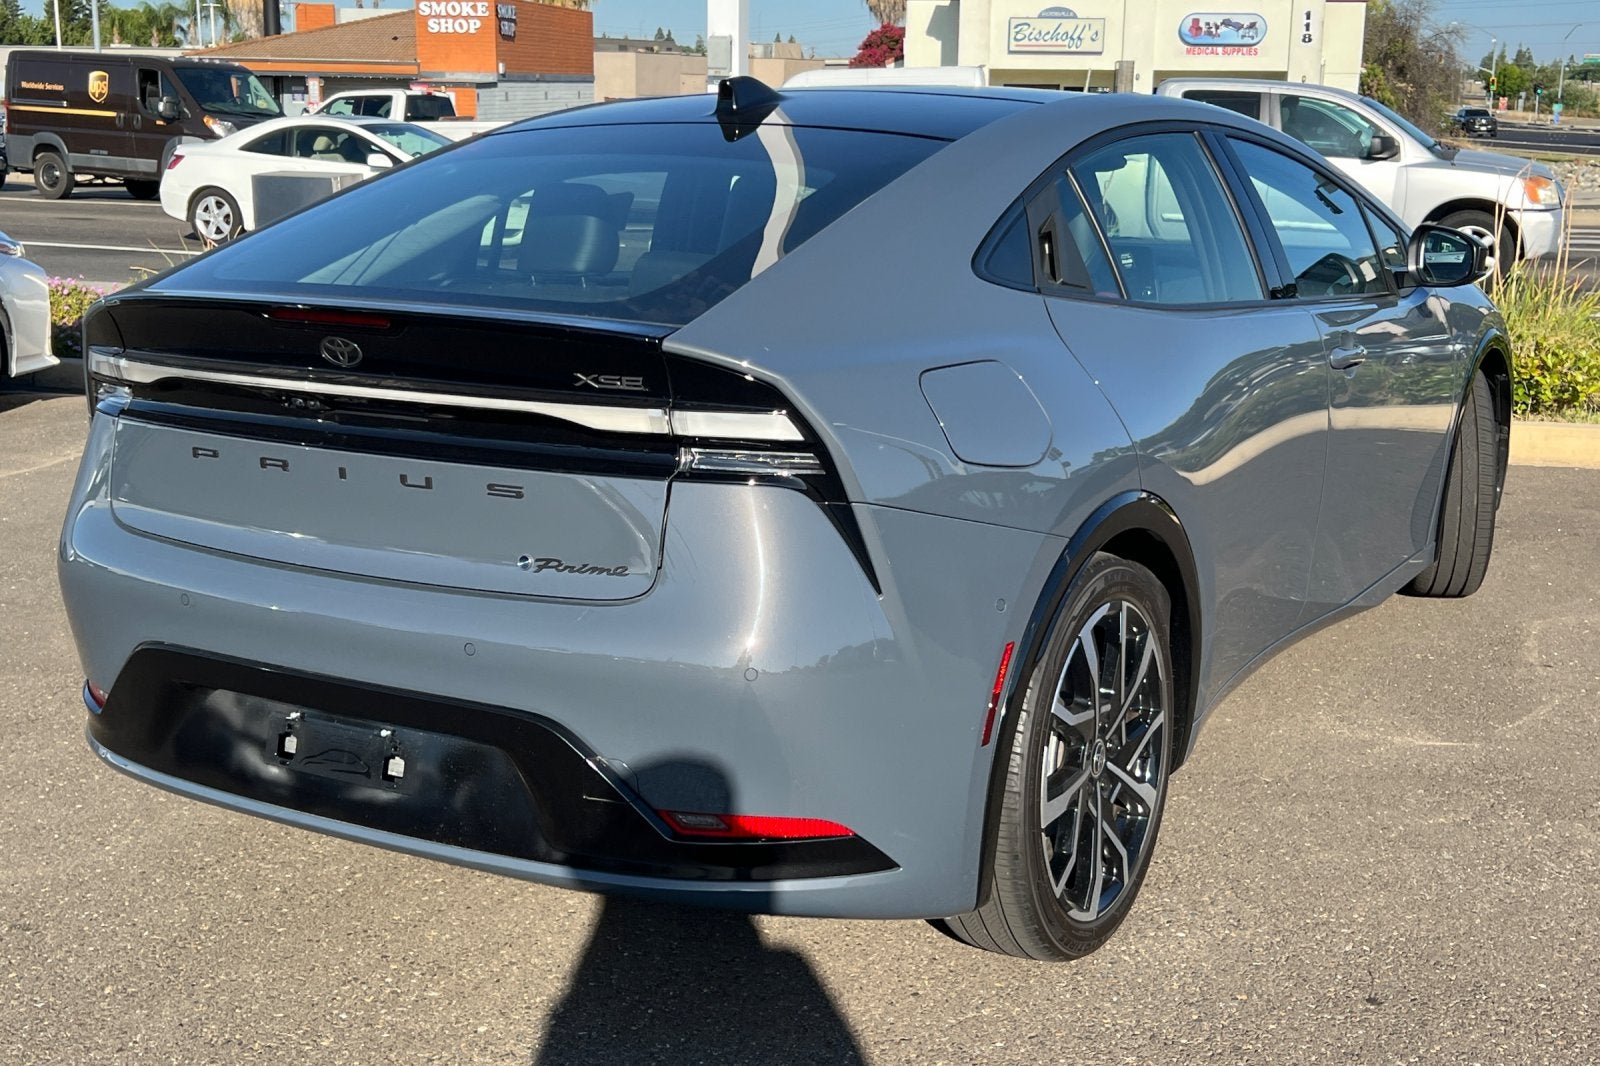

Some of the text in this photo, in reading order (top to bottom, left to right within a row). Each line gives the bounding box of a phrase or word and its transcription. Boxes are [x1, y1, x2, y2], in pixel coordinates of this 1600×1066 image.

[418, 1, 490, 17] SMOKE
[427, 18, 482, 34] SHOP
[1013, 22, 1099, 49] Bischoff's
[1185, 47, 1259, 56] MEDICAL SUPPLIES
[21, 81, 64, 91] Worldwide Services
[90, 80, 108, 98] ups
[573, 372, 645, 391] XSE
[191, 446, 525, 500] PRIUS
[533, 557, 630, 577] Prime
